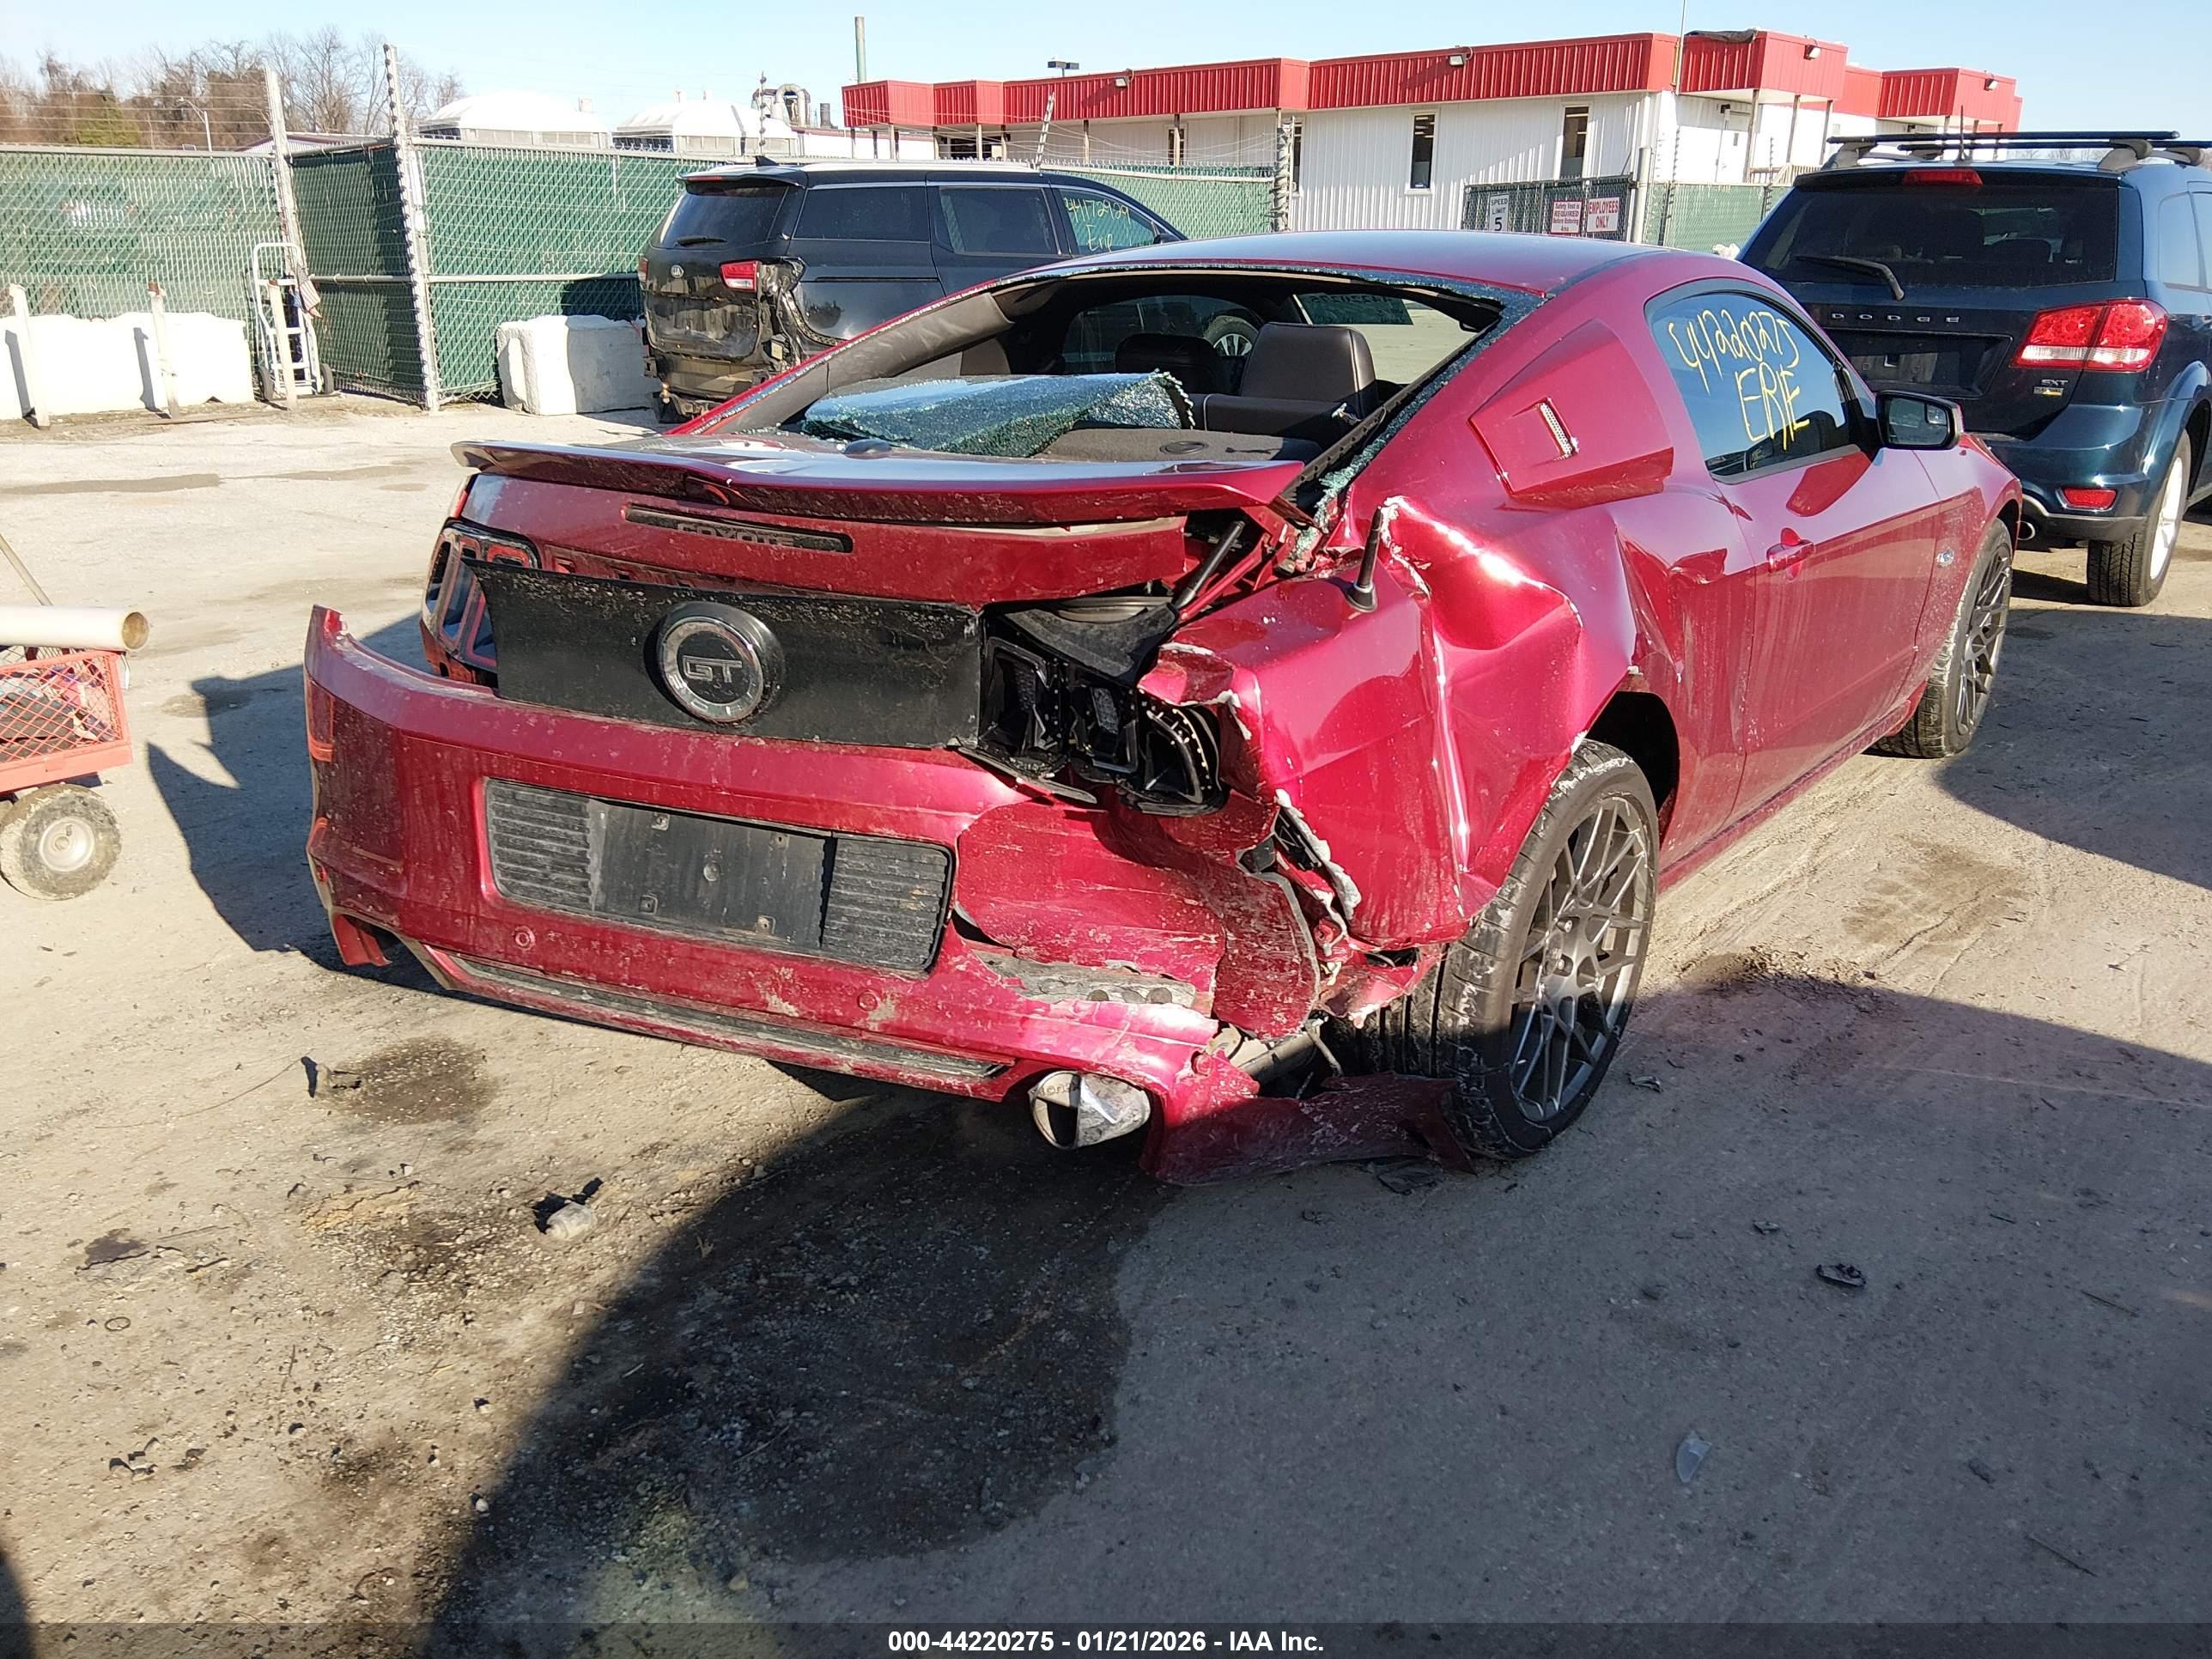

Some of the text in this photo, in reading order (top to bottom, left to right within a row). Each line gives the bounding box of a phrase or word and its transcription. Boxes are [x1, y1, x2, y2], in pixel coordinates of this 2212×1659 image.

[1589, 200, 1619, 215] EMPLOYEES
[1494, 216, 1503, 231] 5
[1595, 215, 1609, 228] ONLY
[1831, 313, 1960, 323] DODGE
[1735, 362, 1810, 451] ERIE
[682, 655, 743, 684] GT
